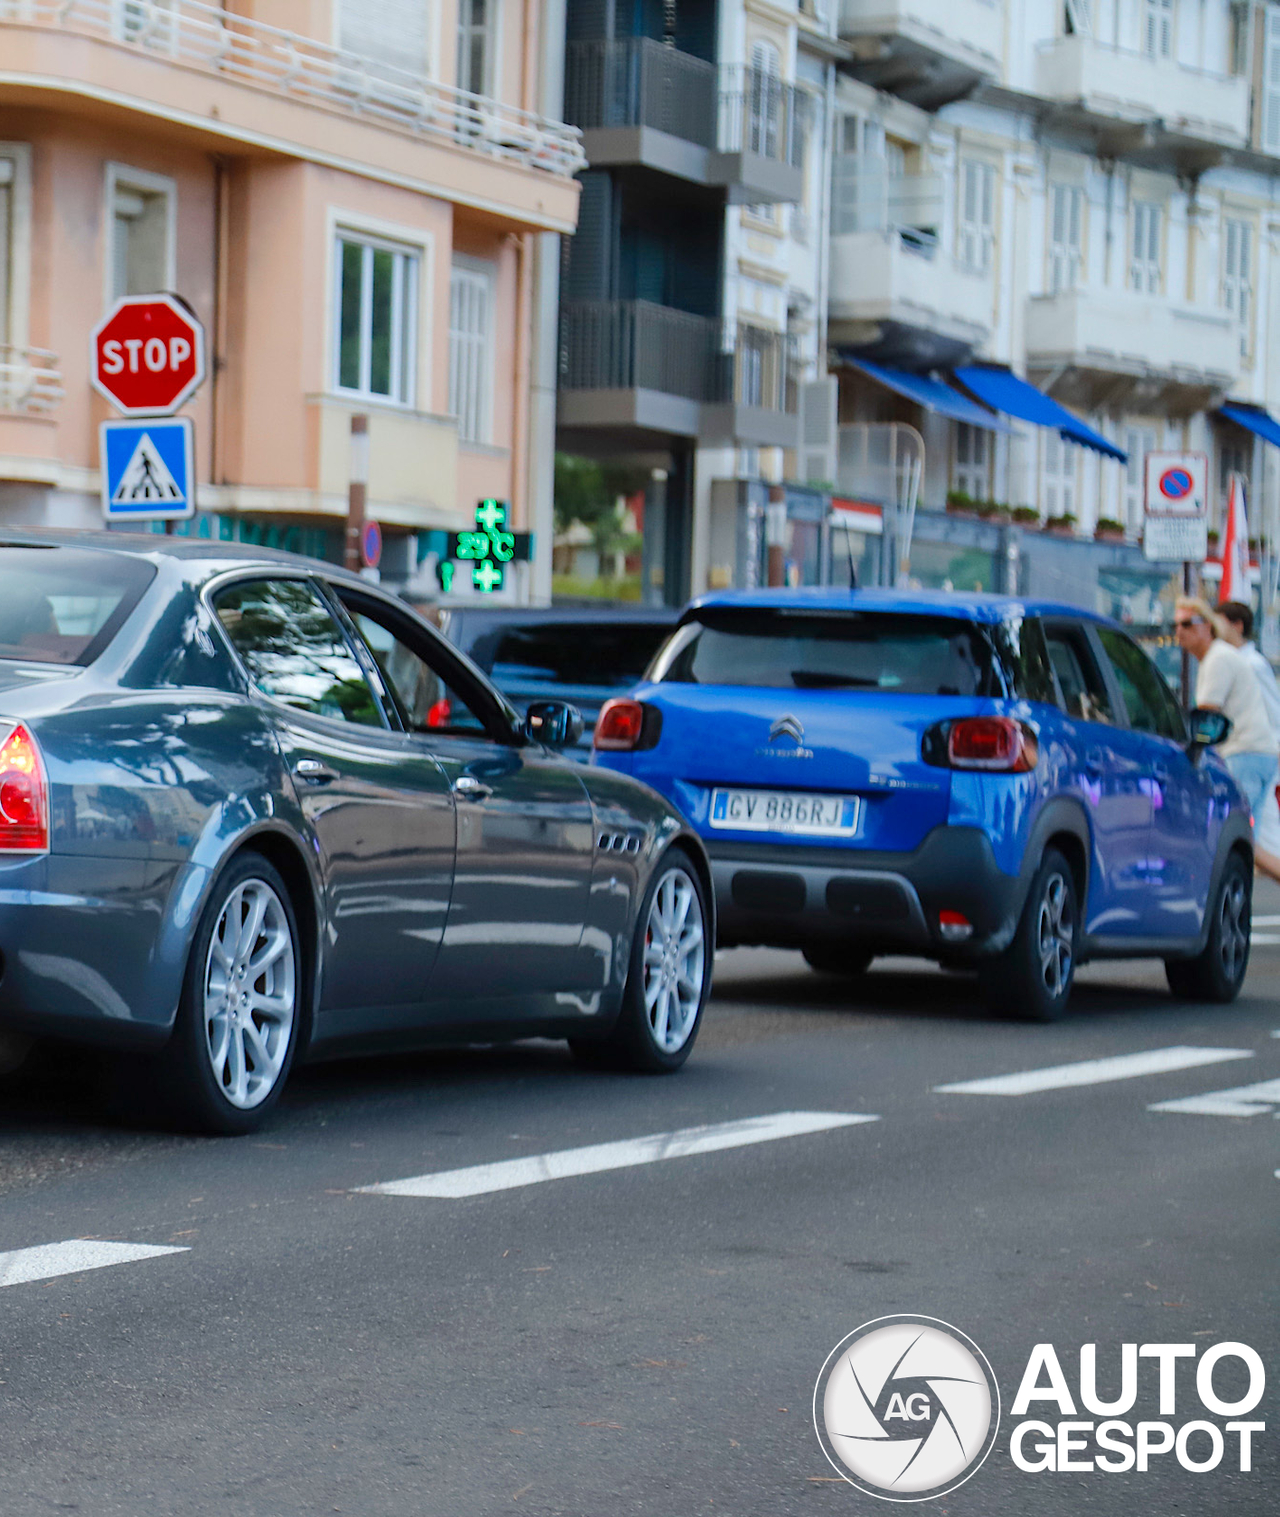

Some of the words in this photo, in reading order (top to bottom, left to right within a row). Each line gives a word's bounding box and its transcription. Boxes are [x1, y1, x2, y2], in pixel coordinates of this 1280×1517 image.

[102, 337, 191, 375] STOP
[730, 794, 758, 820] GV
[766, 797, 840, 827] 886RJ
